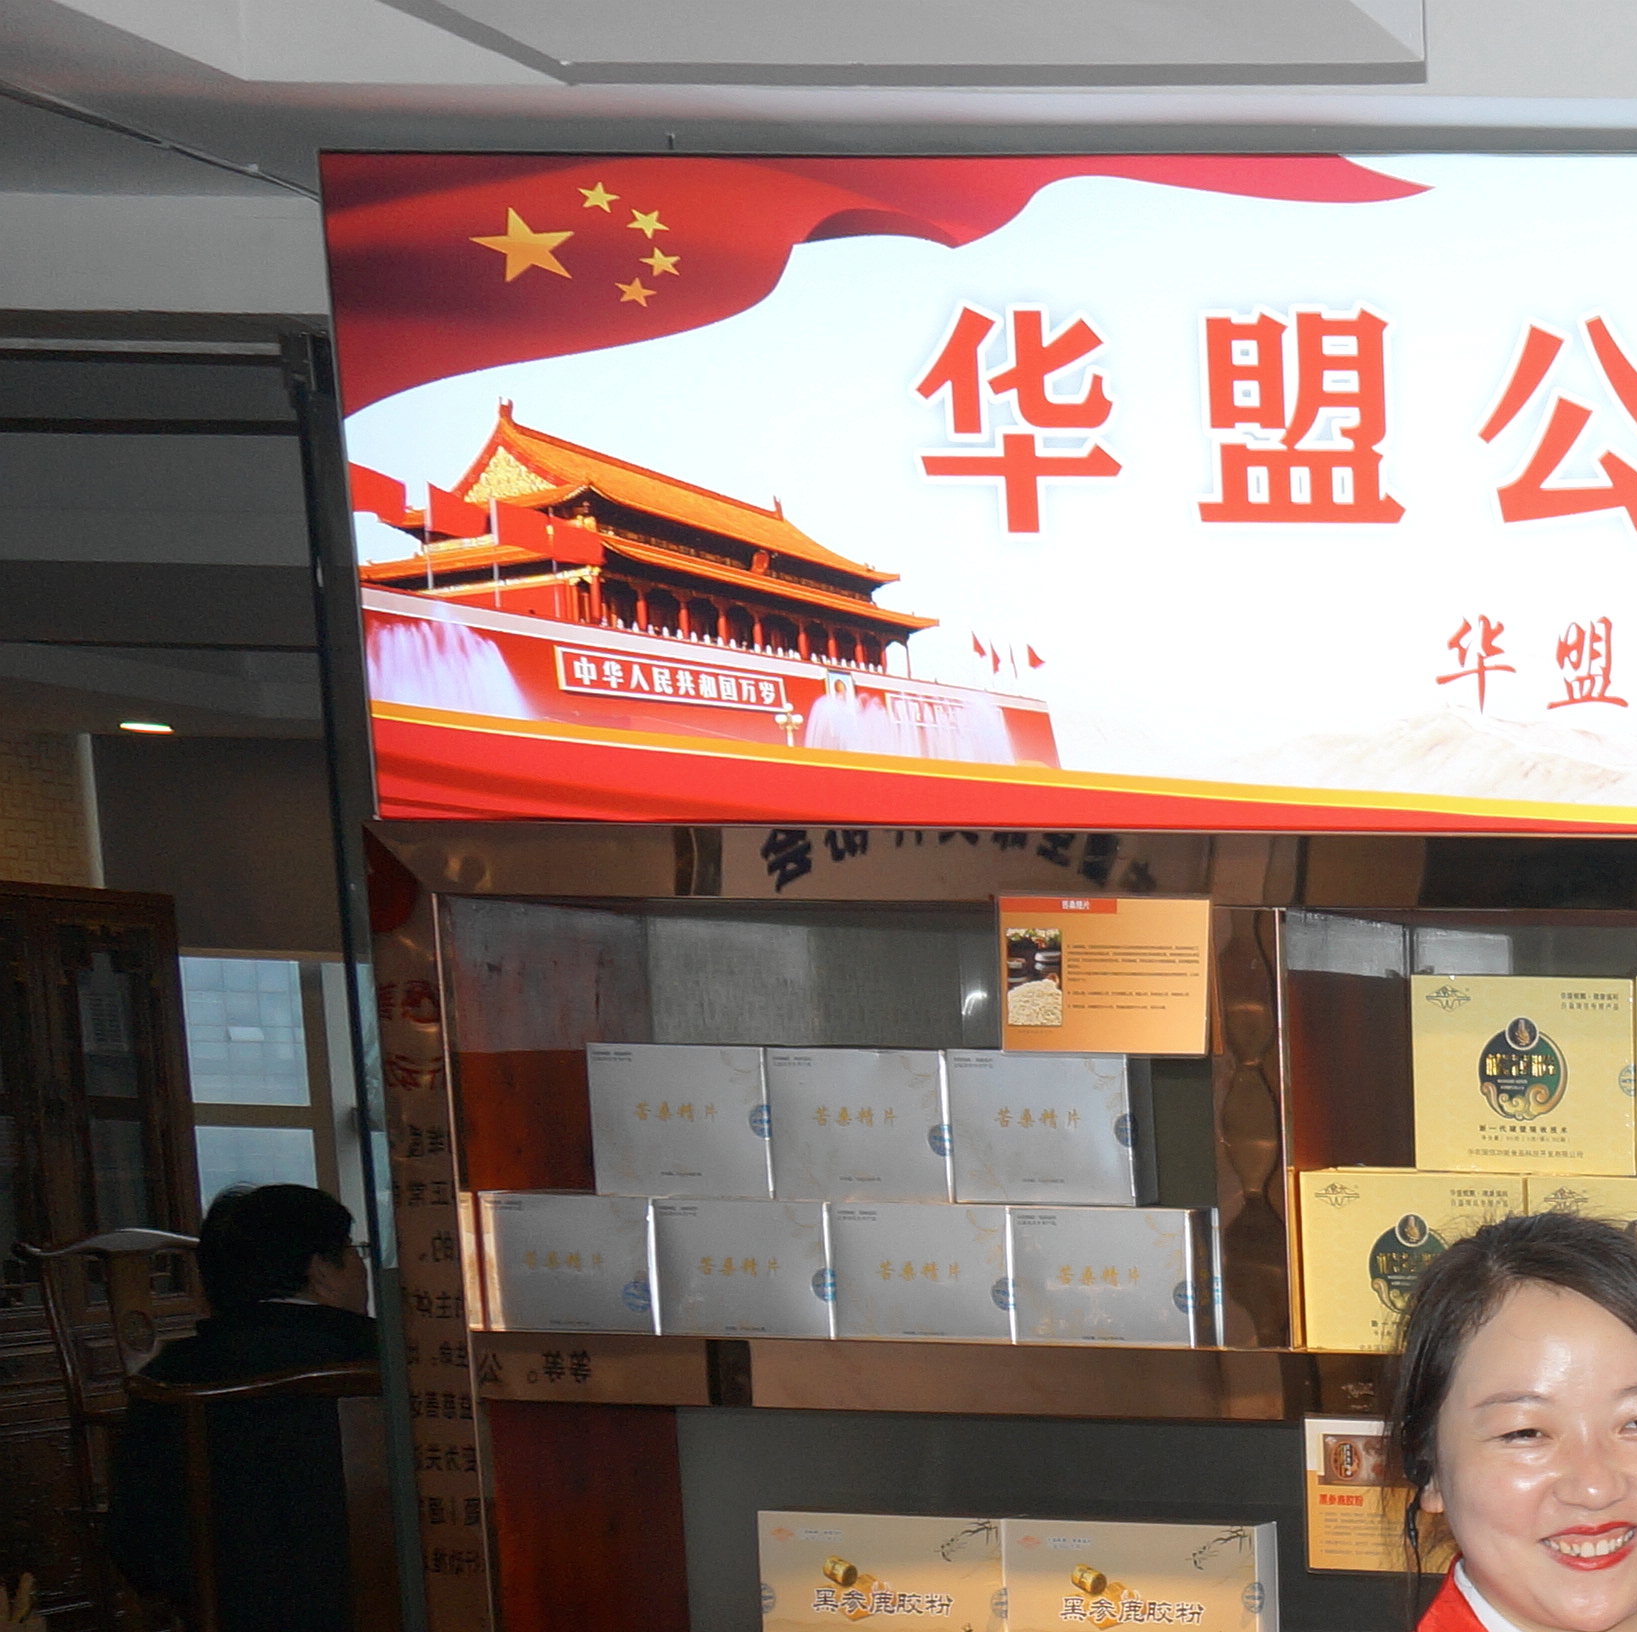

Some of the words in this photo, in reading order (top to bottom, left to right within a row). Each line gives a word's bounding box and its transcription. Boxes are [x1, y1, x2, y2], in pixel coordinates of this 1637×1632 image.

[573, 656, 777, 705] 中华人民共和国万岁
[811, 1587, 953, 1617] 黑参鹿胶粉
[1060, 1596, 1204, 1625] 黑参鹿胶粉
